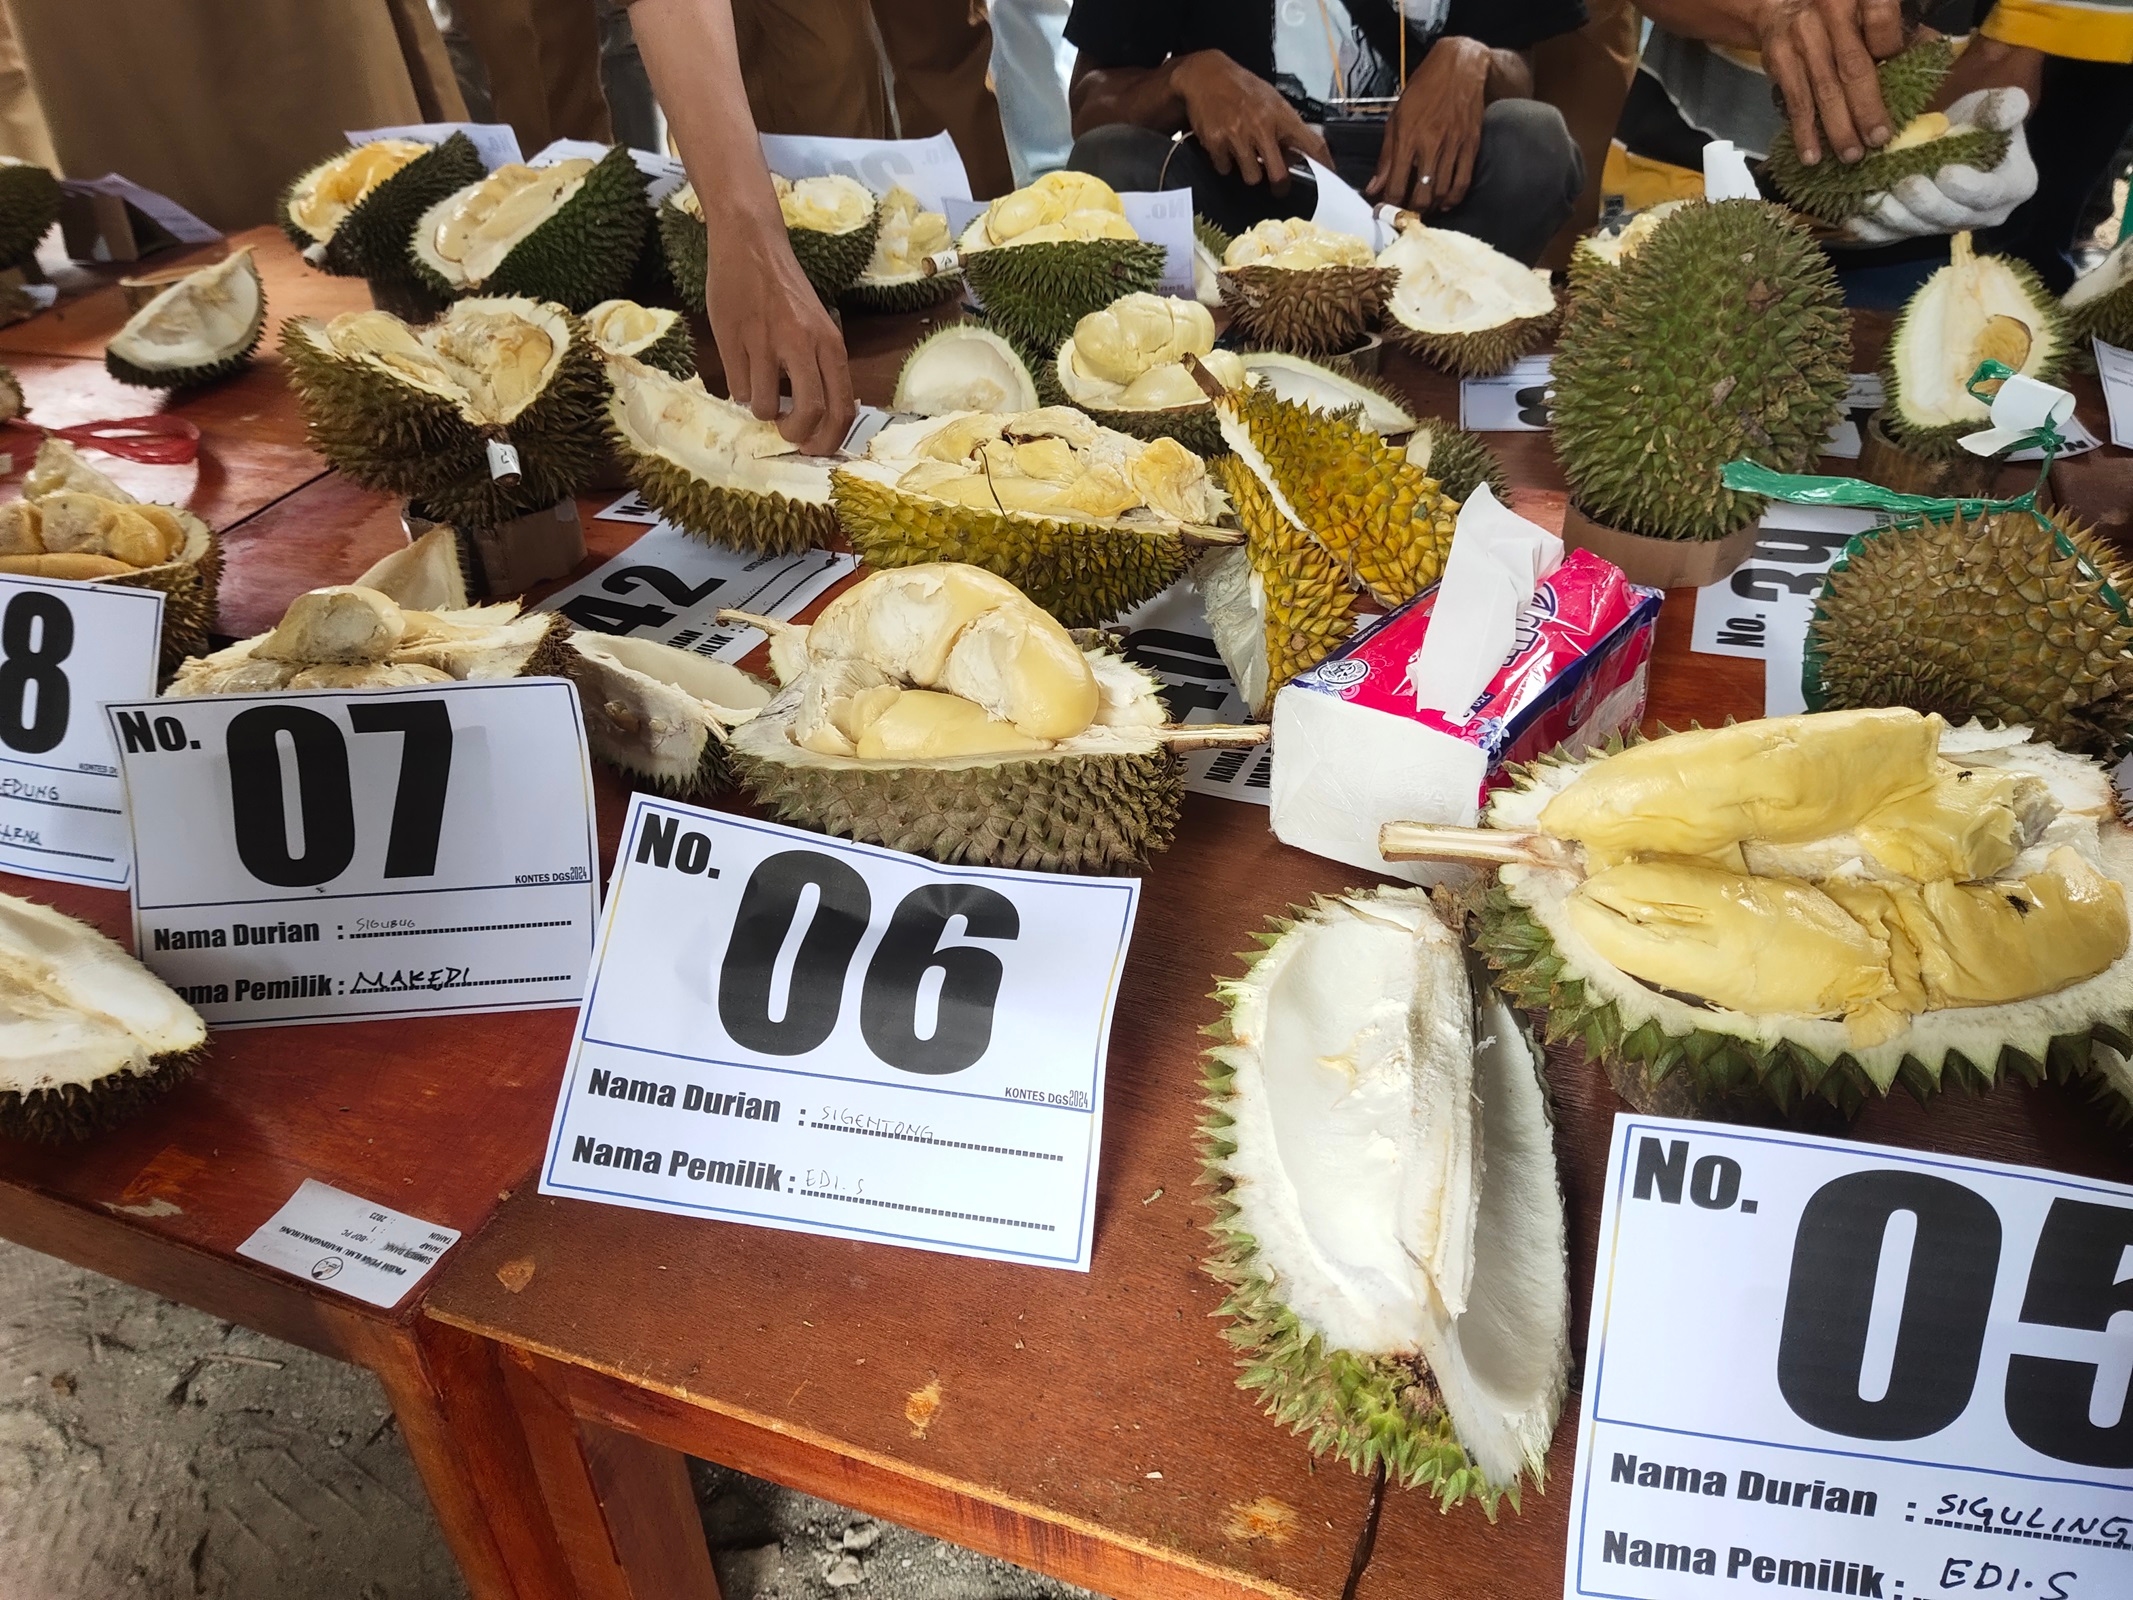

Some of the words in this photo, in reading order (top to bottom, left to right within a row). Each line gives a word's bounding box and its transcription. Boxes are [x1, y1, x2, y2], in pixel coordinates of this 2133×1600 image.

[555, 565, 728, 636] 42
[1716, 614, 1766, 648] No.
[116, 710, 201, 753] No.
[1203, 751, 1250, 784] NAMA
[226, 700, 453, 888] 07
[635, 812, 721, 879] No.
[515, 873, 550, 884] KONTES
[154, 928, 226, 951] Nama
[233, 921, 320, 946] Durian
[351, 966, 469, 992] MAKEDI
[718, 849, 1020, 1075] 06
[175, 983, 228, 1005] ama
[235, 974, 332, 1002] Pemilik
[588, 1068, 676, 1108] Nama
[683, 1084, 781, 1124] Durian
[1005, 1087, 1045, 1102] KONTES
[821, 1105, 934, 1140] SIGENTONG
[572, 1135, 662, 1175] Nama
[668, 1150, 782, 1193] Pemilik
[1632, 1136, 1759, 1214] No.
[369, 1212, 388, 1223] 2023
[428, 1231, 453, 1244] TAHUN
[1777, 1169, 2133, 1469] 05
[1610, 1452, 1727, 1497] Nama
[1737, 1469, 1878, 1518] Durian
[1937, 1494, 2133, 1546] SIGULING
[1602, 1530, 1717, 1577] Nama
[1727, 1546, 1885, 1600] Pemilik
